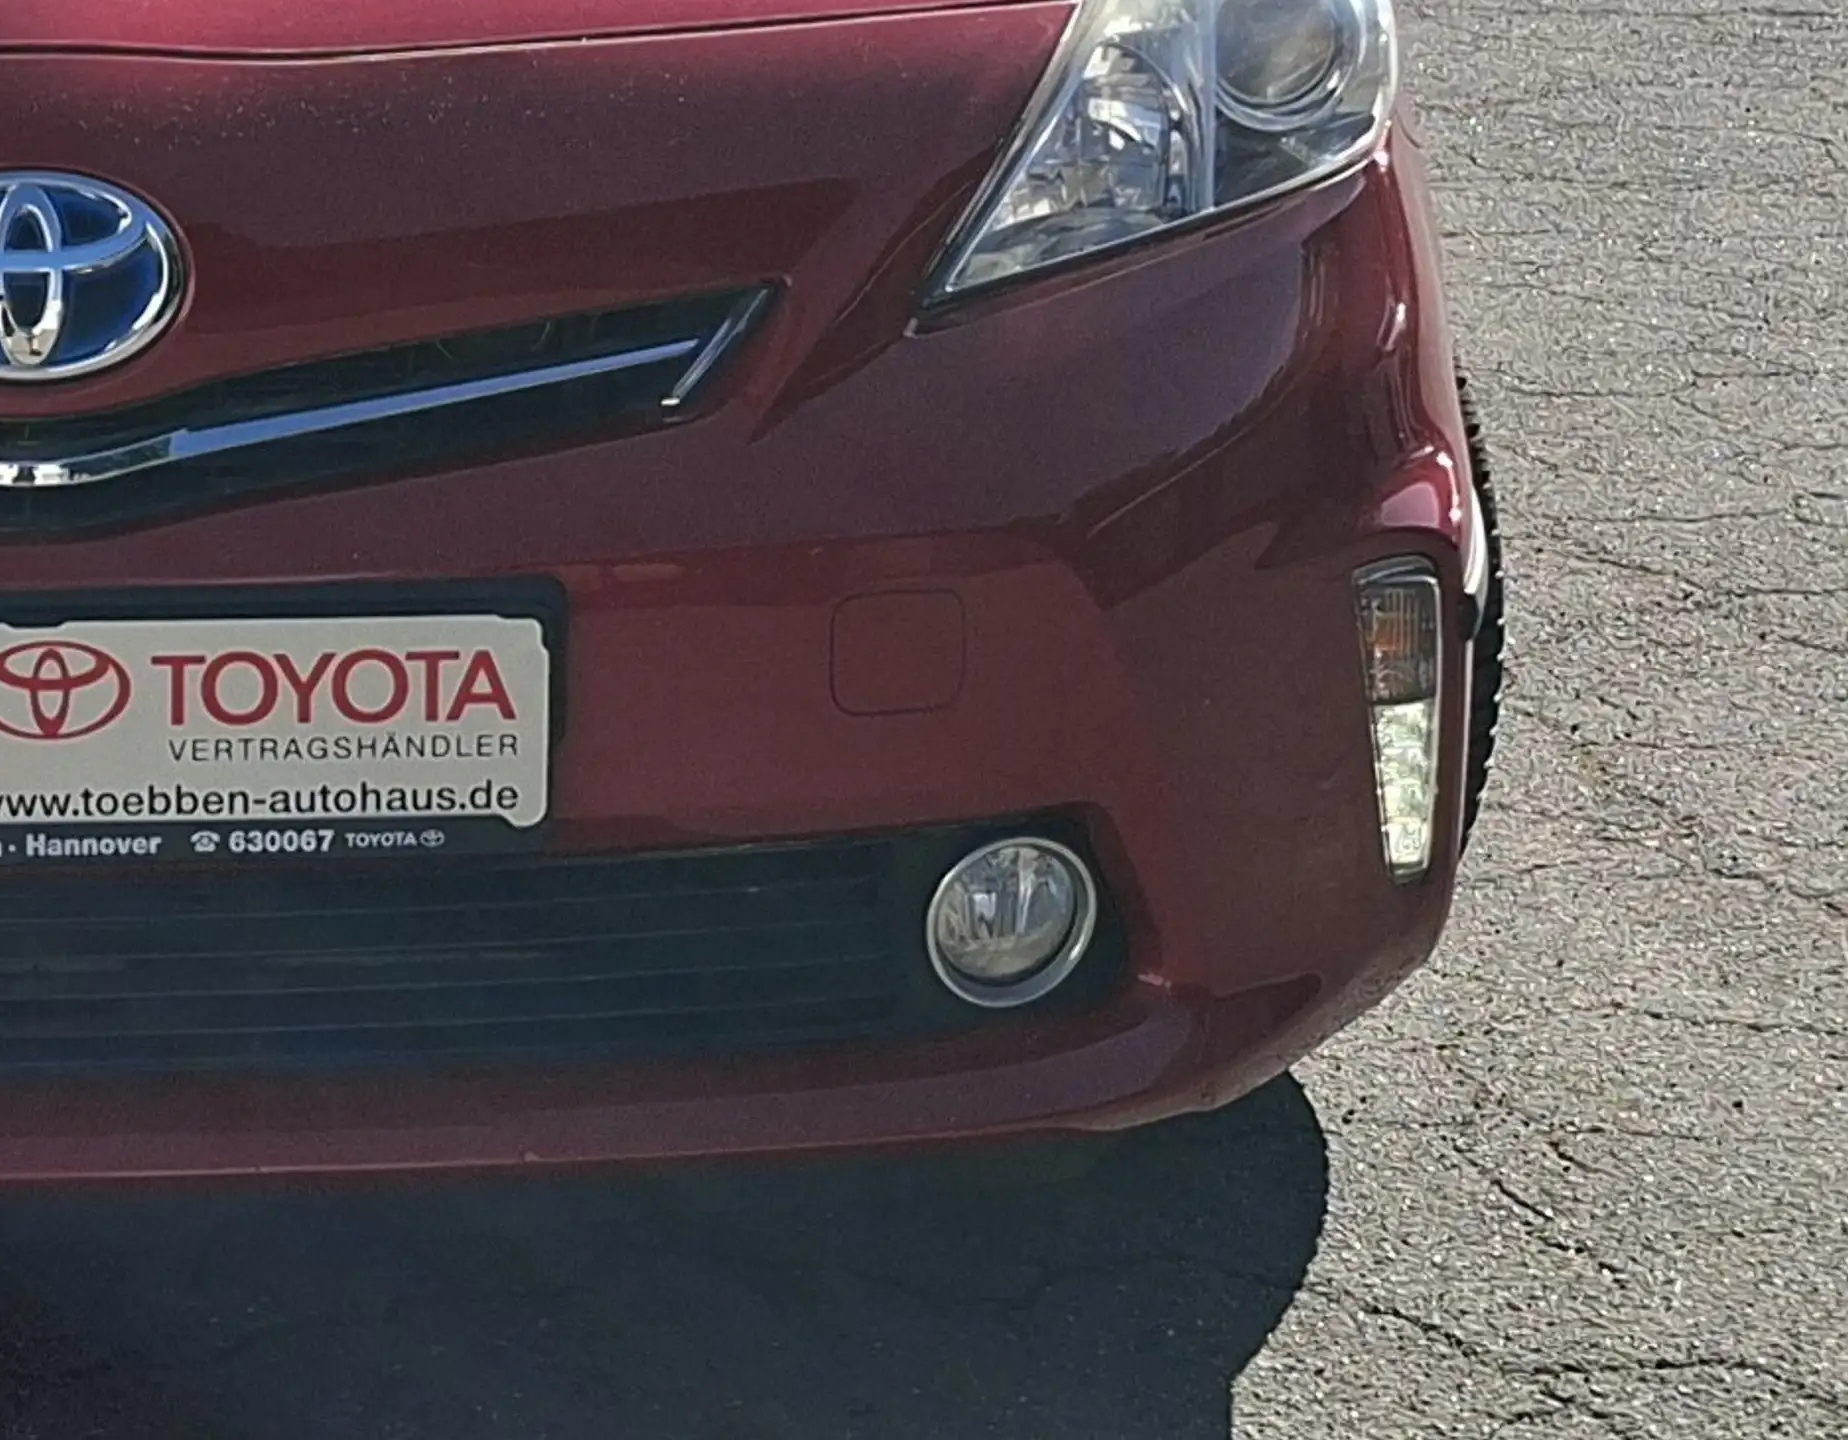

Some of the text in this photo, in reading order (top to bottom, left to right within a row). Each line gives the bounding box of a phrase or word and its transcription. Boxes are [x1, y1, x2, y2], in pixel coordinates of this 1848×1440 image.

[151, 648, 517, 726] TOYOTA
[168, 731, 519, 762] VERTRAGSHÄNDLER
[25, 832, 163, 858] Hannover
[228, 828, 336, 854] 630067
[345, 831, 418, 849] TOYOTA
